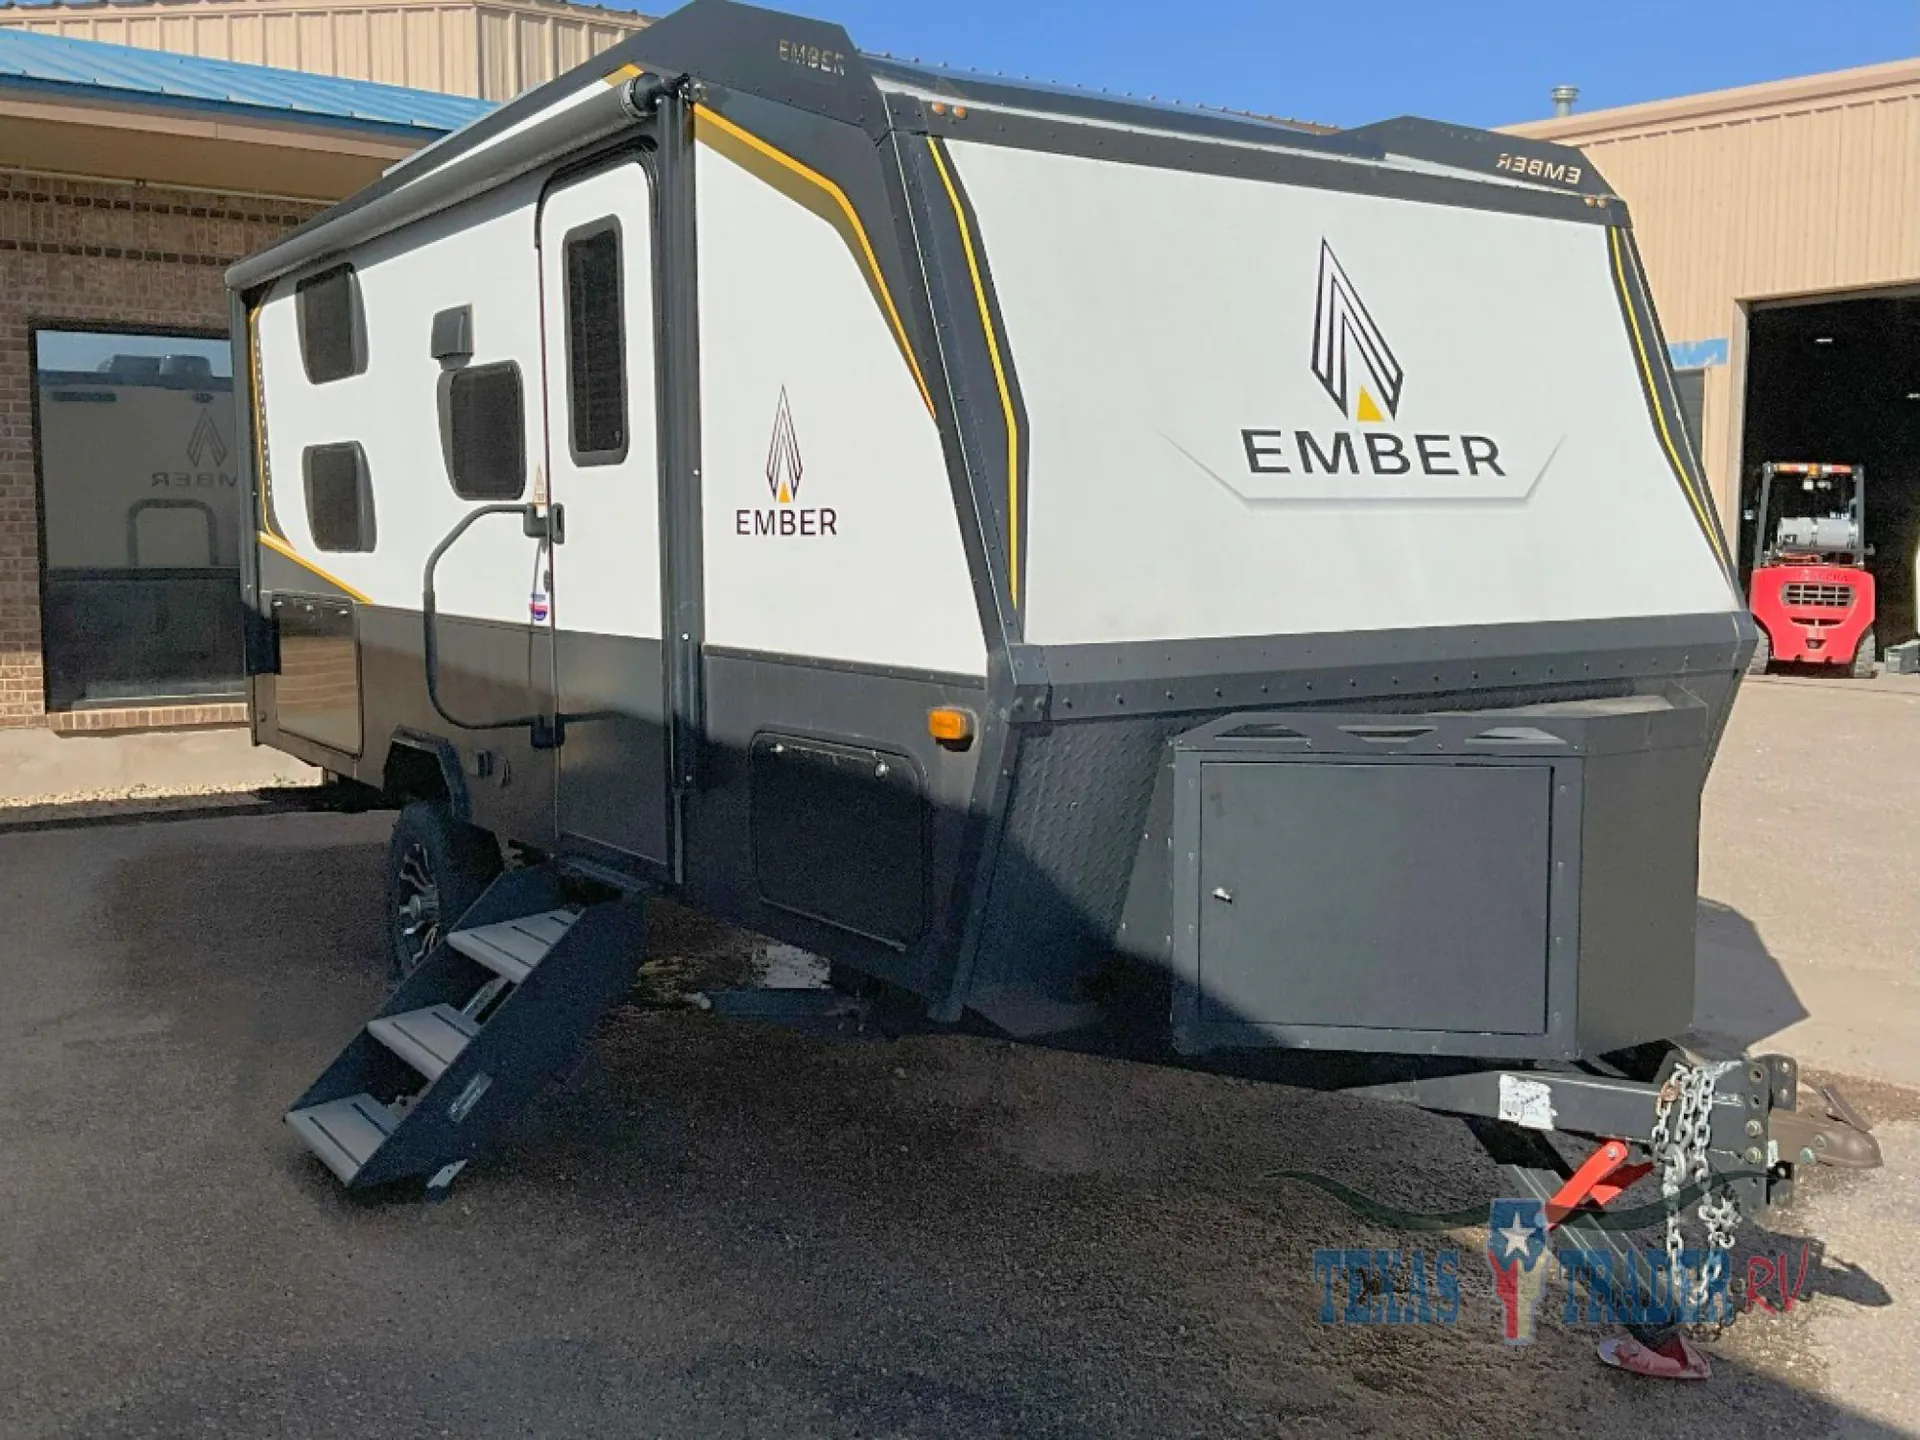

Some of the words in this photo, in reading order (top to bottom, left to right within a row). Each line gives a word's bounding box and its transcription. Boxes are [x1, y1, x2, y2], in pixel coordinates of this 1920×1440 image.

[779, 39, 845, 76] EMBER
[1240, 428, 1506, 476] EMBER
[736, 508, 837, 536] EMBER
